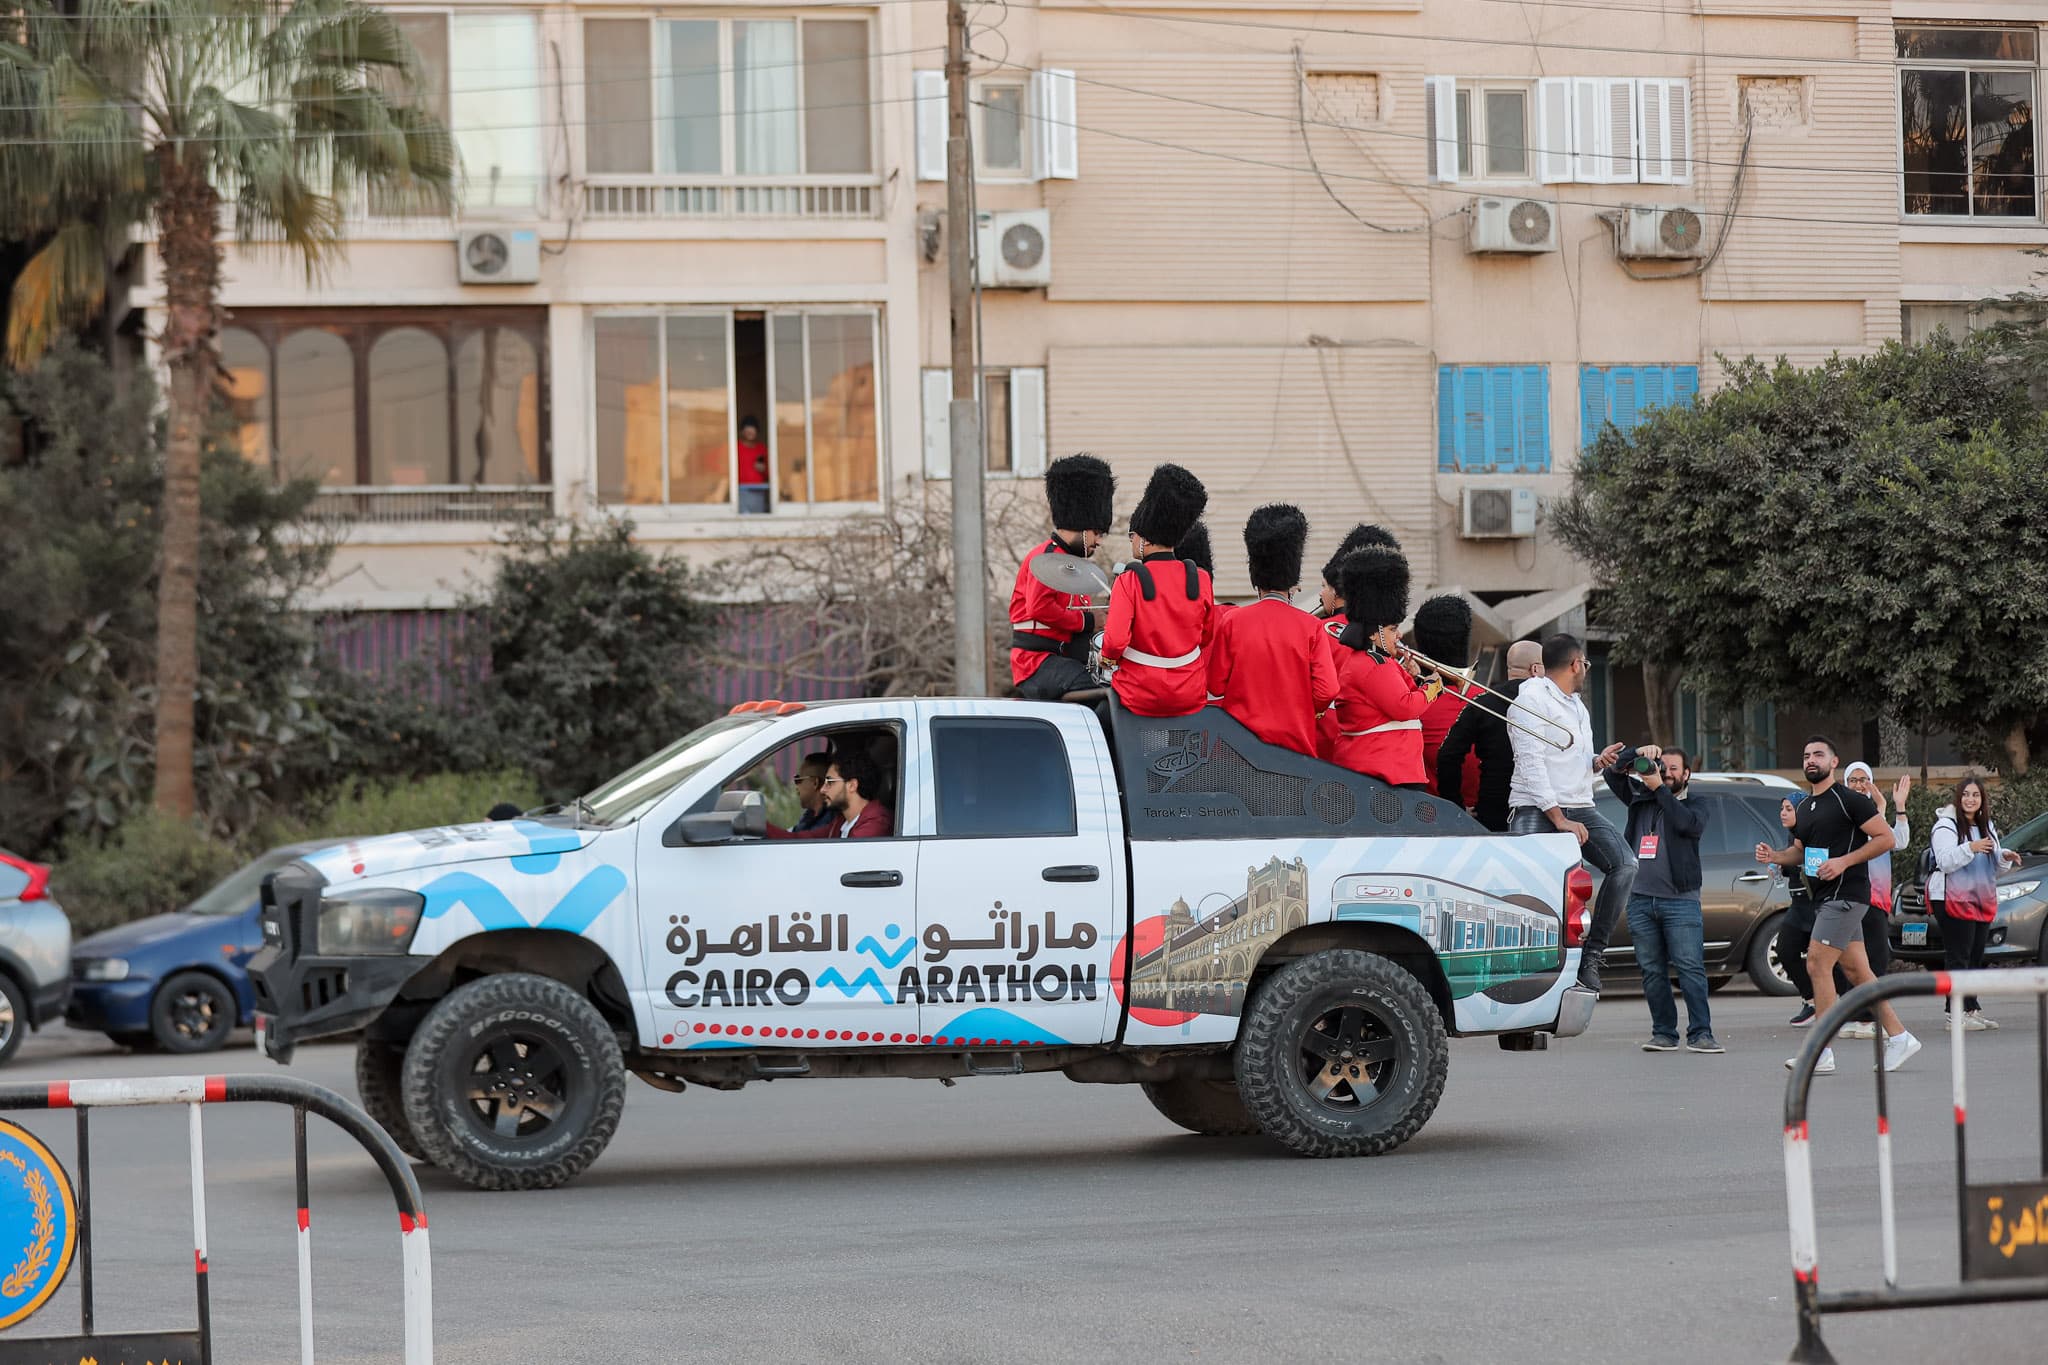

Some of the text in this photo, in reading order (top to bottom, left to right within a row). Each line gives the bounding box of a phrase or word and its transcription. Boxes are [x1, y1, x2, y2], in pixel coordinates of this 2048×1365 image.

[1144, 807, 1176, 817] Tarek
[666, 911, 849, 966] القاهرة
[665, 968, 810, 1008] CAIRO
